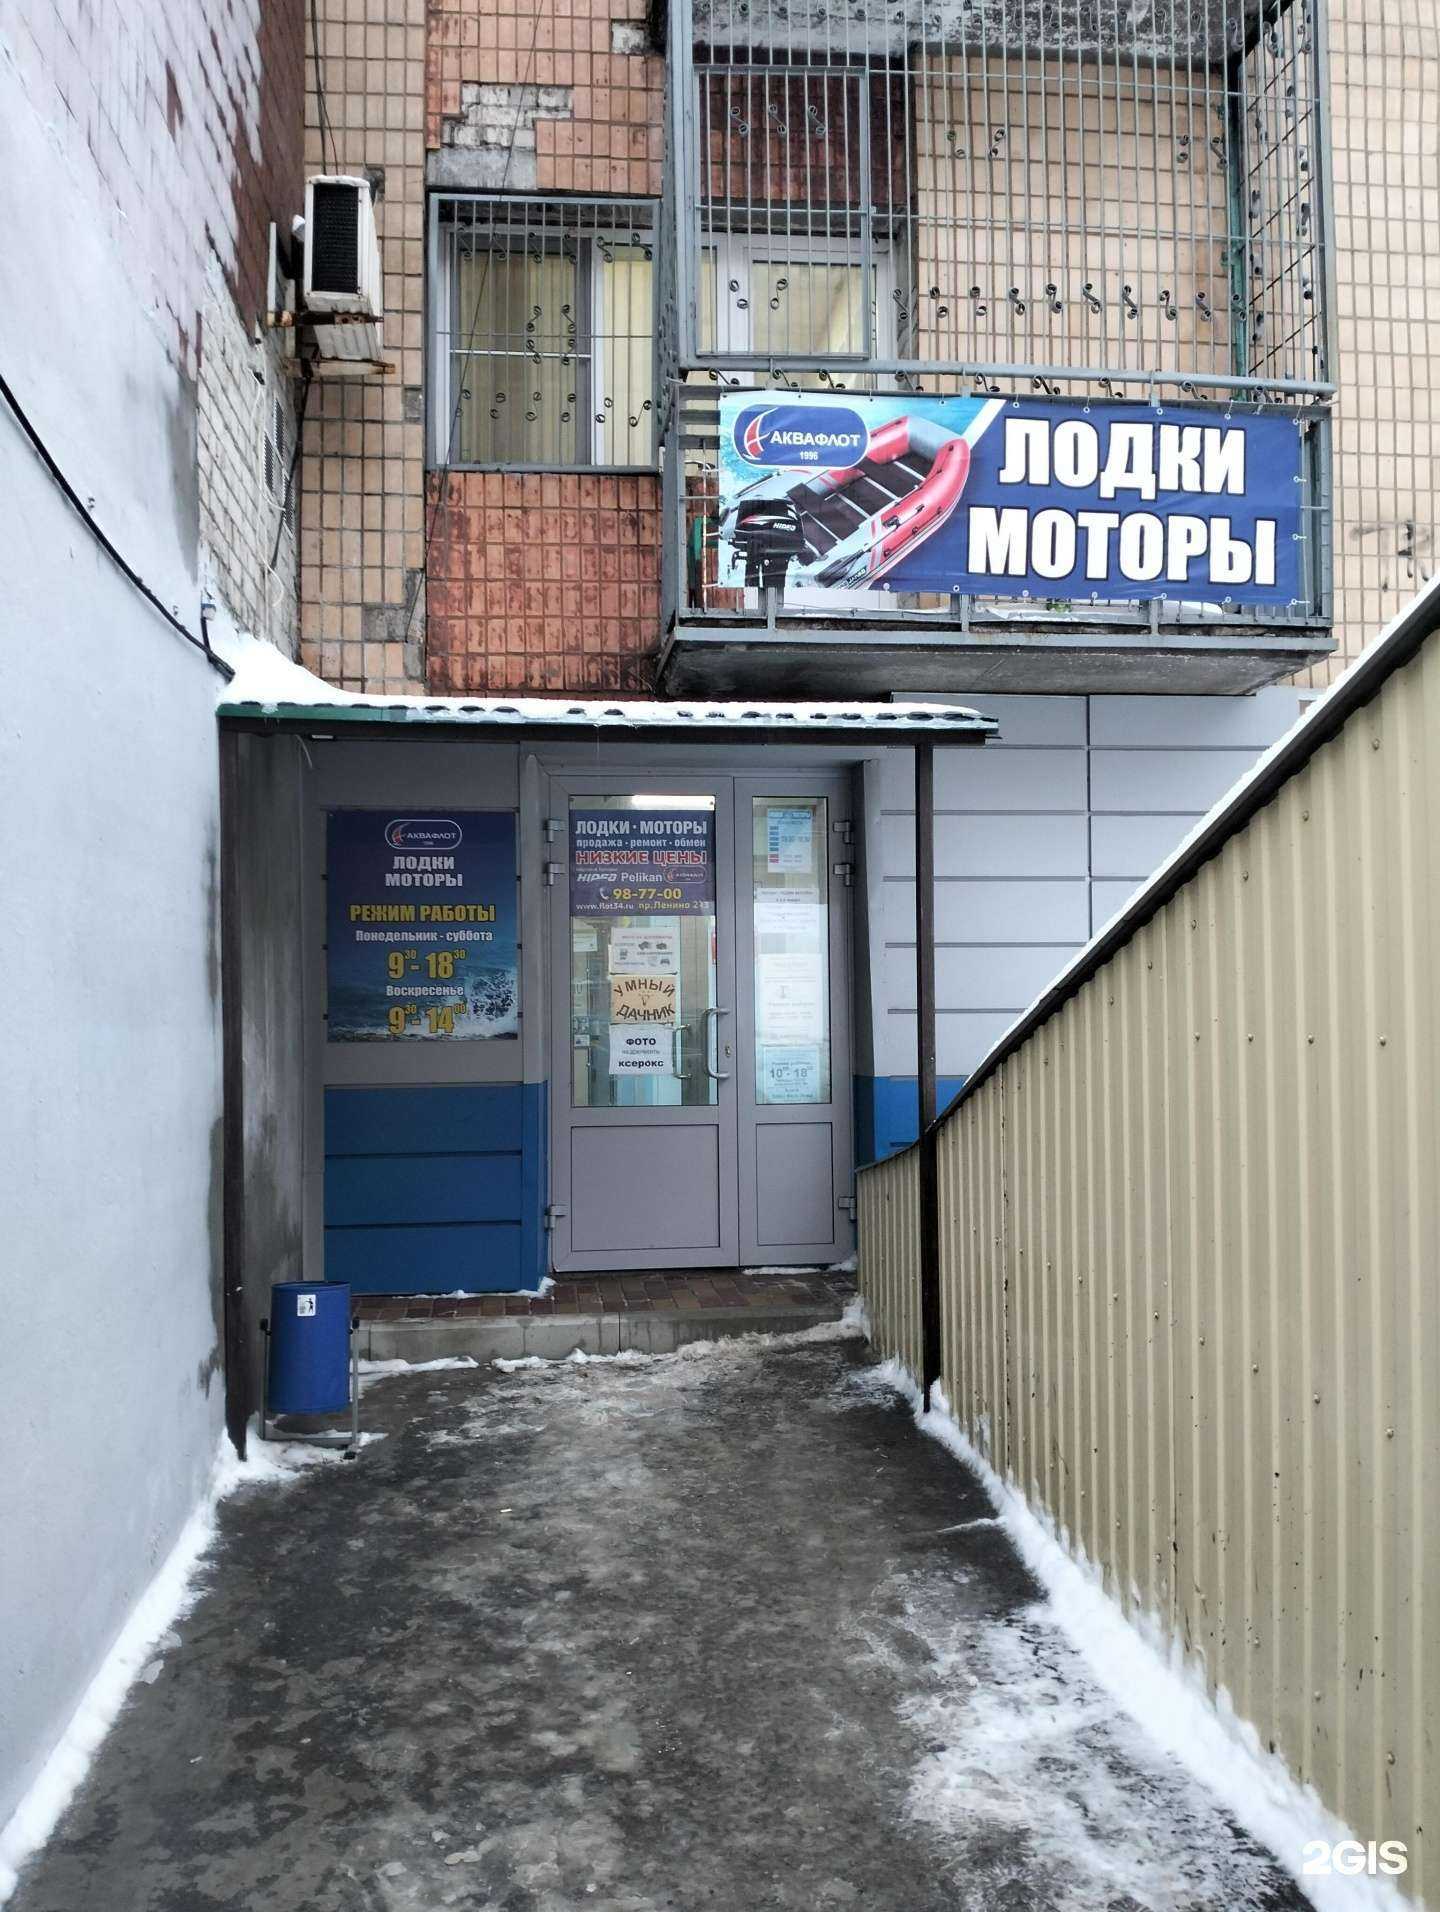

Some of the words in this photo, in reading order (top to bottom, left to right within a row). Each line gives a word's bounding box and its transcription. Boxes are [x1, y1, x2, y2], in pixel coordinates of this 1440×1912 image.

[770, 430, 860, 447] АКВАФЛОТ
[800, 451, 818, 460] 1996
[1000, 417, 1245, 498] ЛОДКИ
[967, 506, 1276, 585] МОТОРЫ
[575, 820, 630, 836] ЛОДКИ
[640, 820, 707, 835] МОТОРЫ
[576, 839, 623, 848] продажа
[630, 839, 667, 848] ремонт
[674, 838, 706, 847] обмен
[392, 856, 455, 871] ЛОДКИ
[575, 850, 649, 865] НИЗКИЕ
[653, 850, 707, 866] ЦЕНЫ
[385, 873, 463, 887] МОТОРЫ
[621, 872, 663, 882] Pelikan
[613, 888, 682, 900] 98-77-00
[350, 905, 415, 922] РЕЖИМ
[420, 905, 495, 922] РАБОТЫ
[356, 930, 437, 942] Понедельник
[446, 930, 493, 942] суббота
[386, 985, 464, 997] Воскресенье
[613, 979, 676, 997] УМНЫЙ
[616, 1003, 676, 1021] ДАЧНИК
[626, 1038, 656, 1046] ФОТО
[618, 1060, 664, 1068] ксерокс
